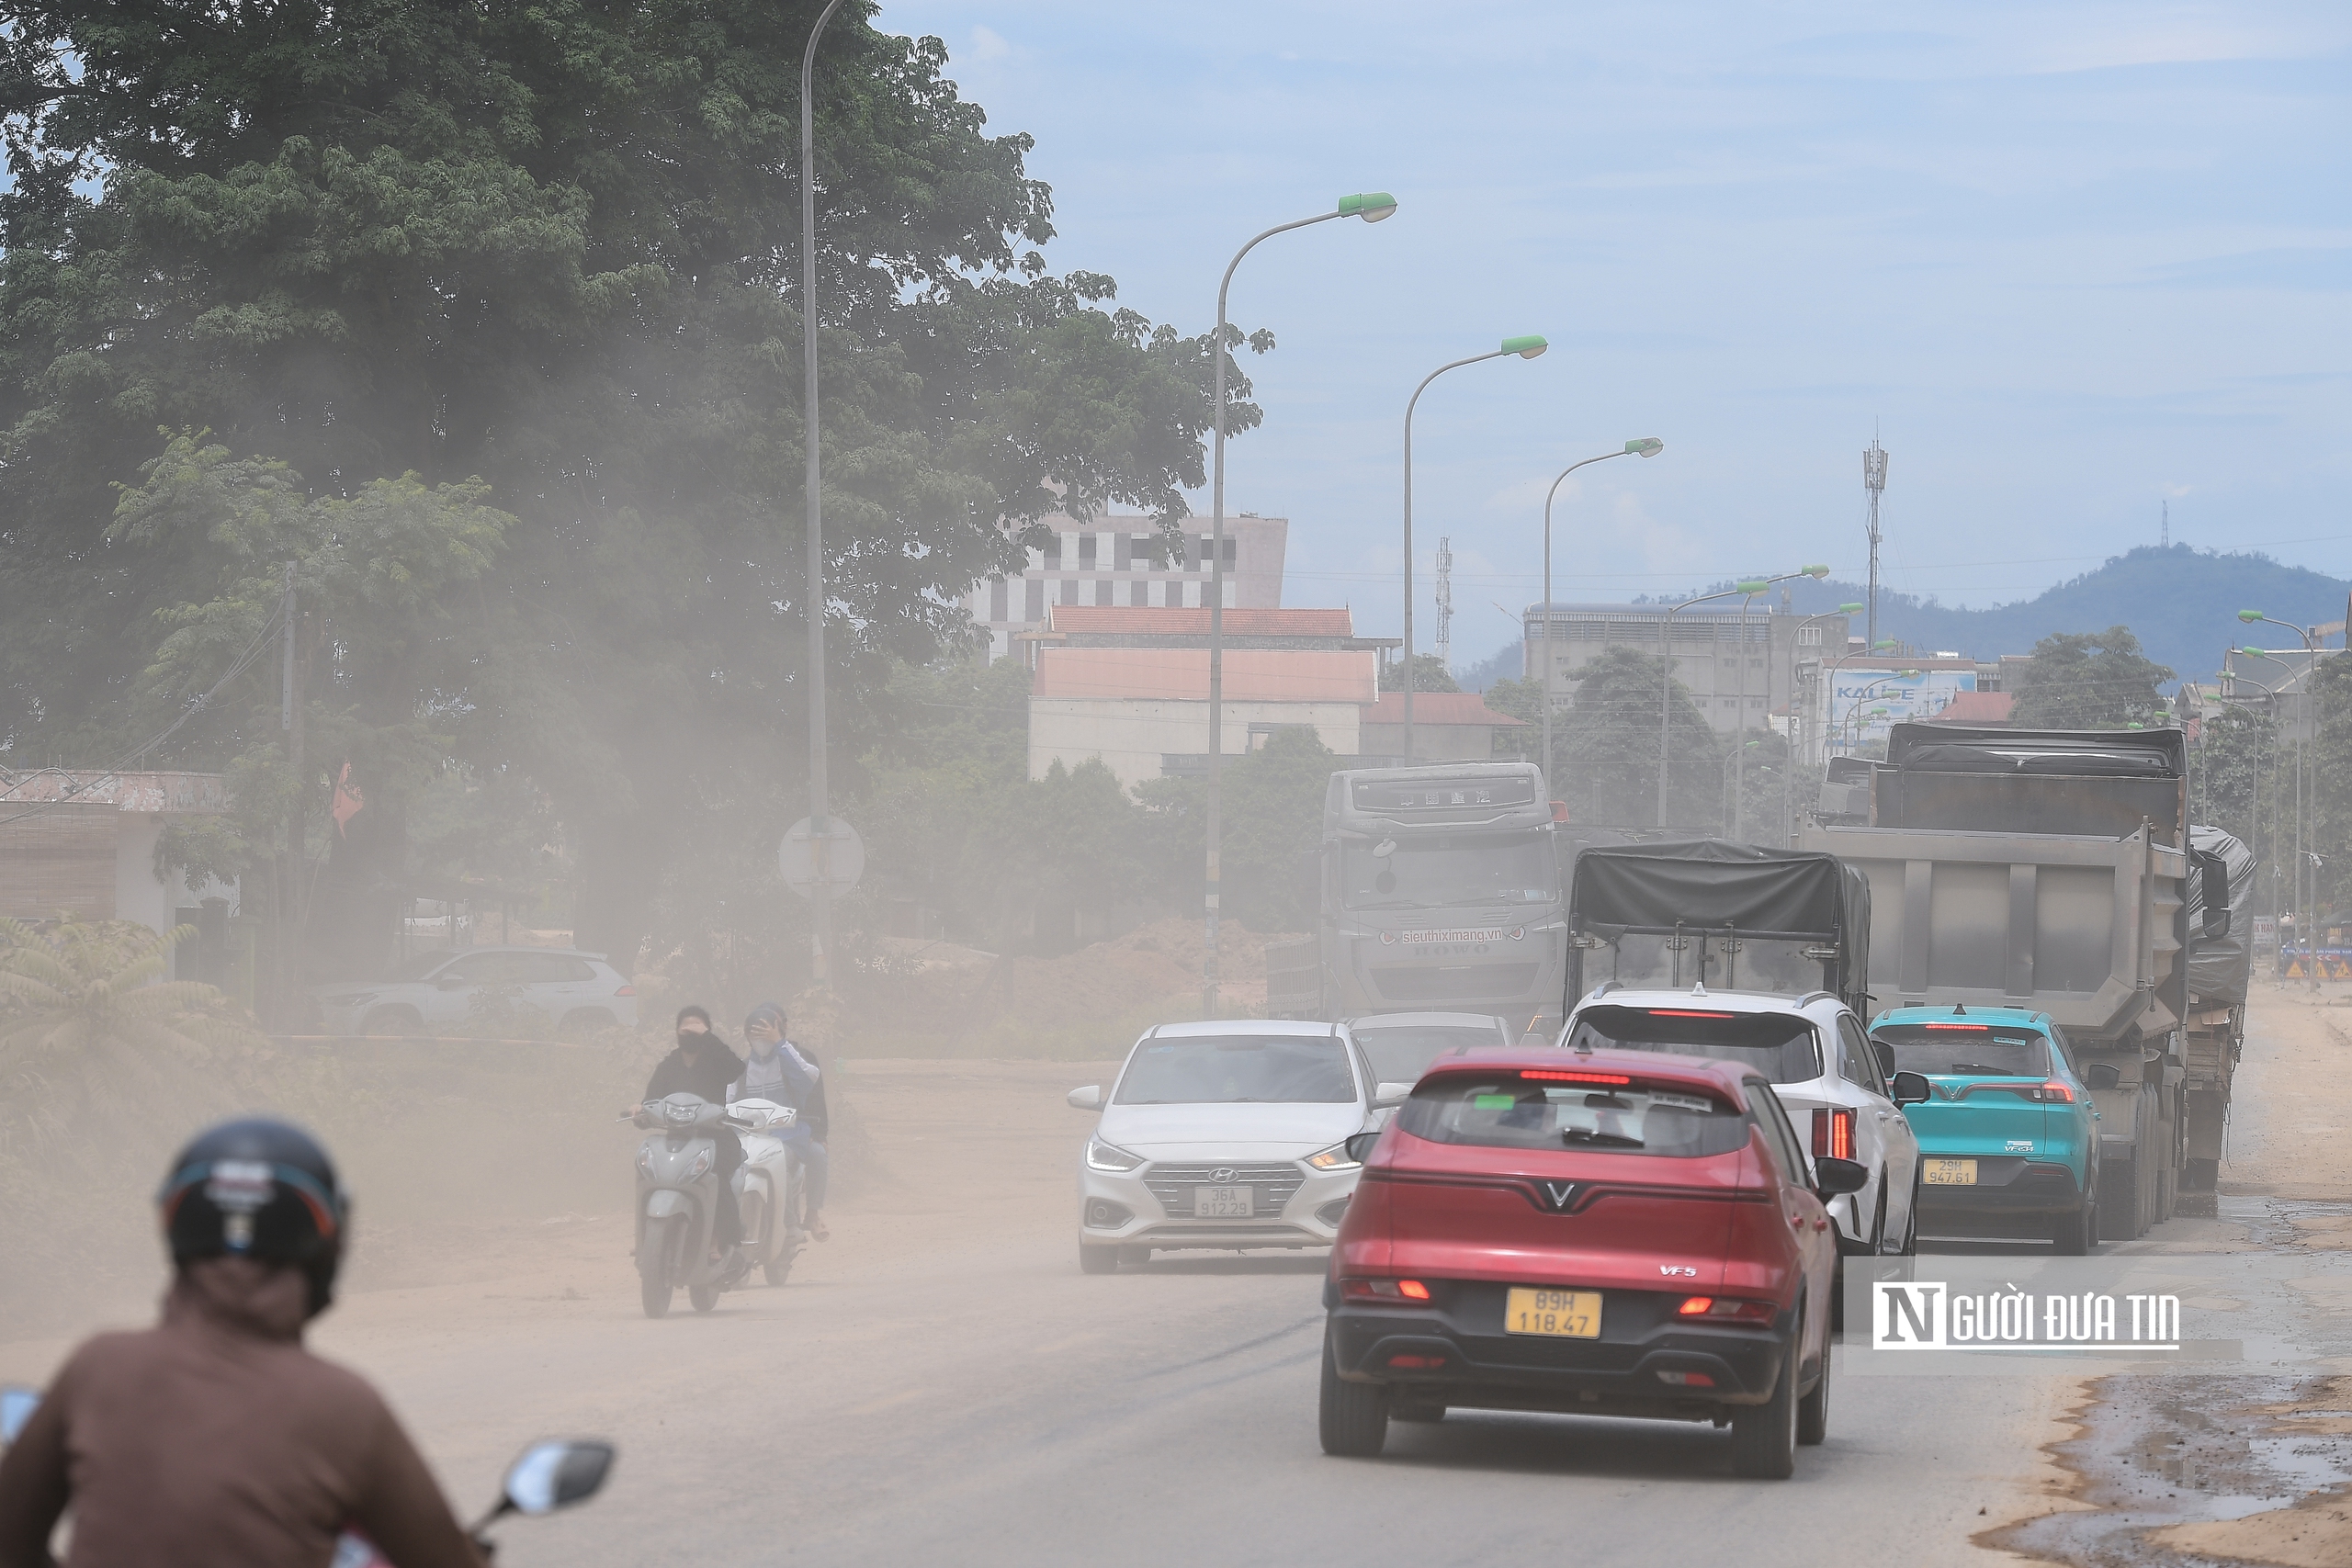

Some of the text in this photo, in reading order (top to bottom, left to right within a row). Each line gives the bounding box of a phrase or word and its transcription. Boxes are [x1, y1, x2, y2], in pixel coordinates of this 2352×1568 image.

[1838, 686, 1915, 700] KALIE
[1403, 929, 1502, 944] sieuthiximang.vn
[1414, 944, 1490, 956] HOWO
[1939, 1160, 1962, 1171] 29H
[1929, 1172, 1970, 1183] 947.61
[1212, 1189, 1236, 1201] 36A
[1201, 1202, 1247, 1215] 912.29
[1535, 1292, 1575, 1312] 89H
[1521, 1312, 1589, 1334] 118.47
